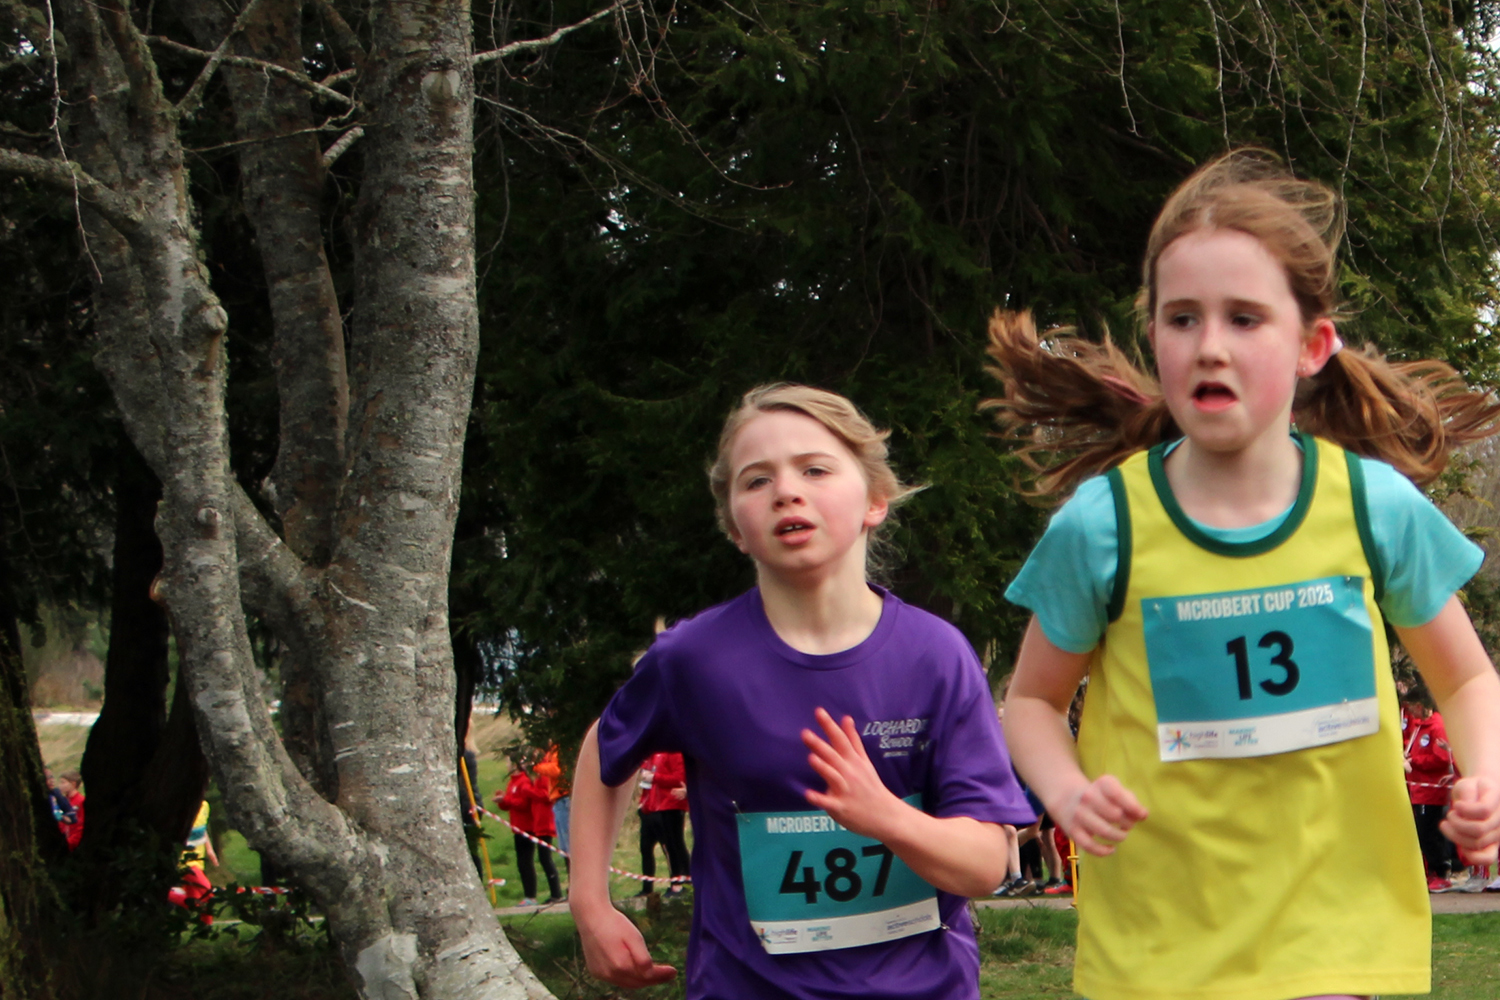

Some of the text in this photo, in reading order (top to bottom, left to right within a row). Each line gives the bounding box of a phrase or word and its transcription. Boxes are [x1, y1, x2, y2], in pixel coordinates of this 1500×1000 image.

[1177, 584, 1334, 622] MCROBERT CUP 2025
[1226, 630, 1300, 700] 13
[767, 816, 836, 834] MCROBERT
[780, 843, 895, 904] 487
